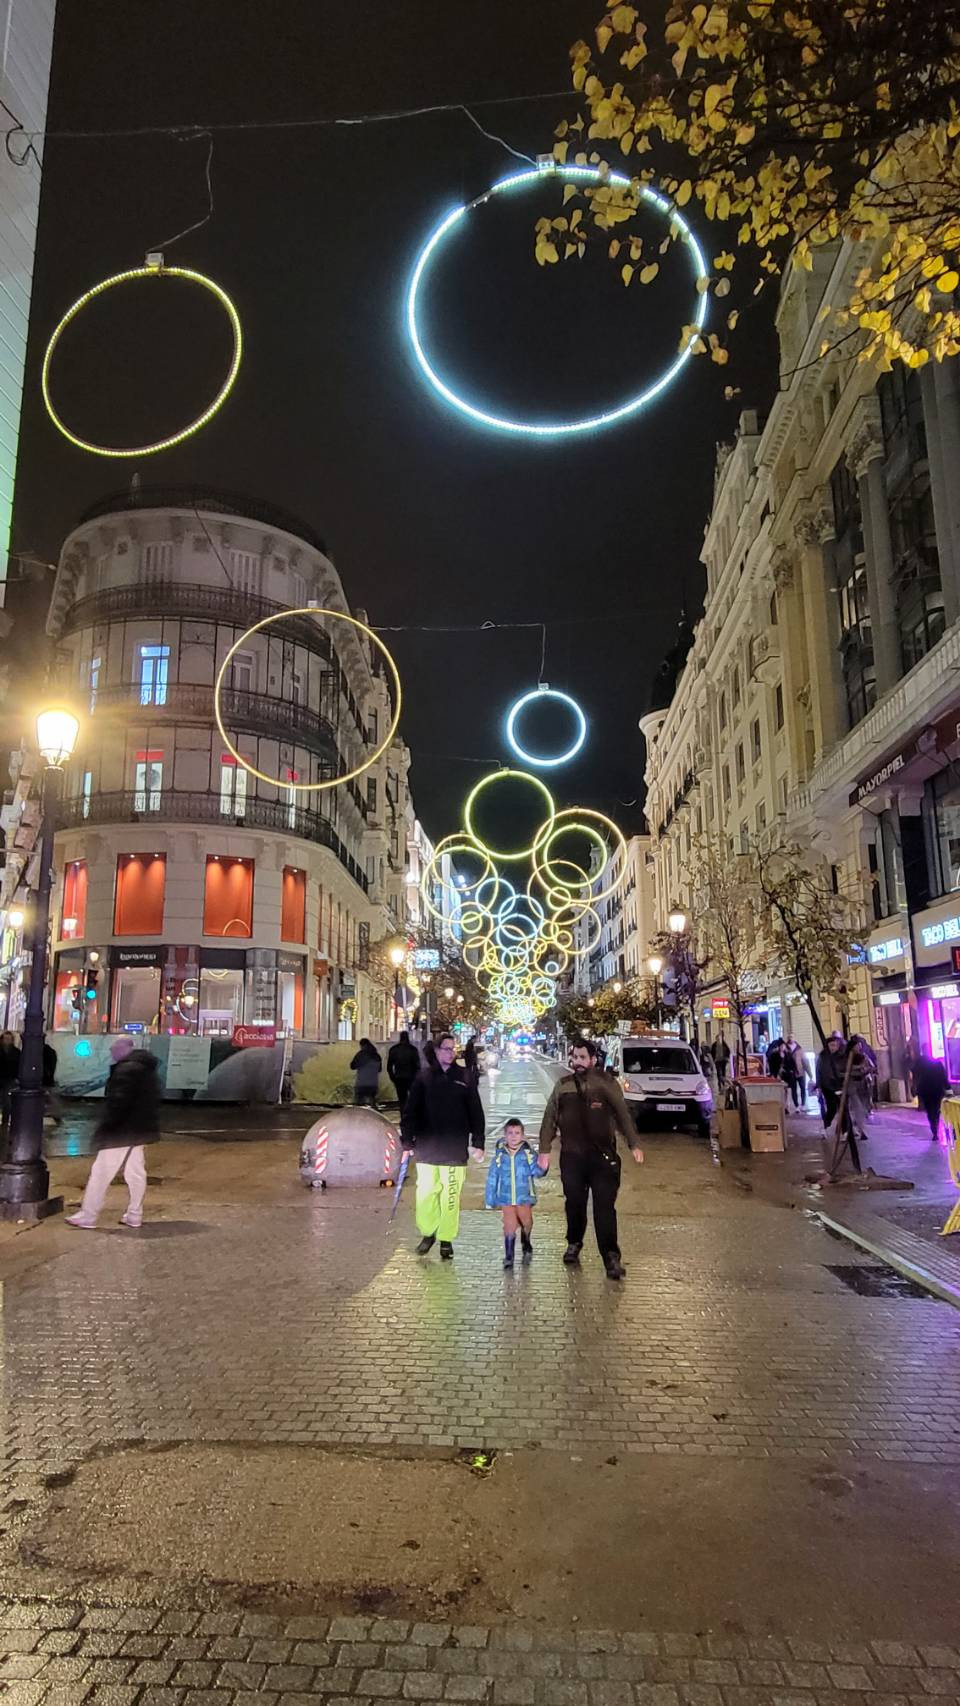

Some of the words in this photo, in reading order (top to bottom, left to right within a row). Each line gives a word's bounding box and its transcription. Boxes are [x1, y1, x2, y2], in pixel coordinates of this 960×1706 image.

[857, 754, 905, 800] MAYORPIEL
[922, 923, 945, 947] TACO
[243, 1031, 274, 1041] acciona
